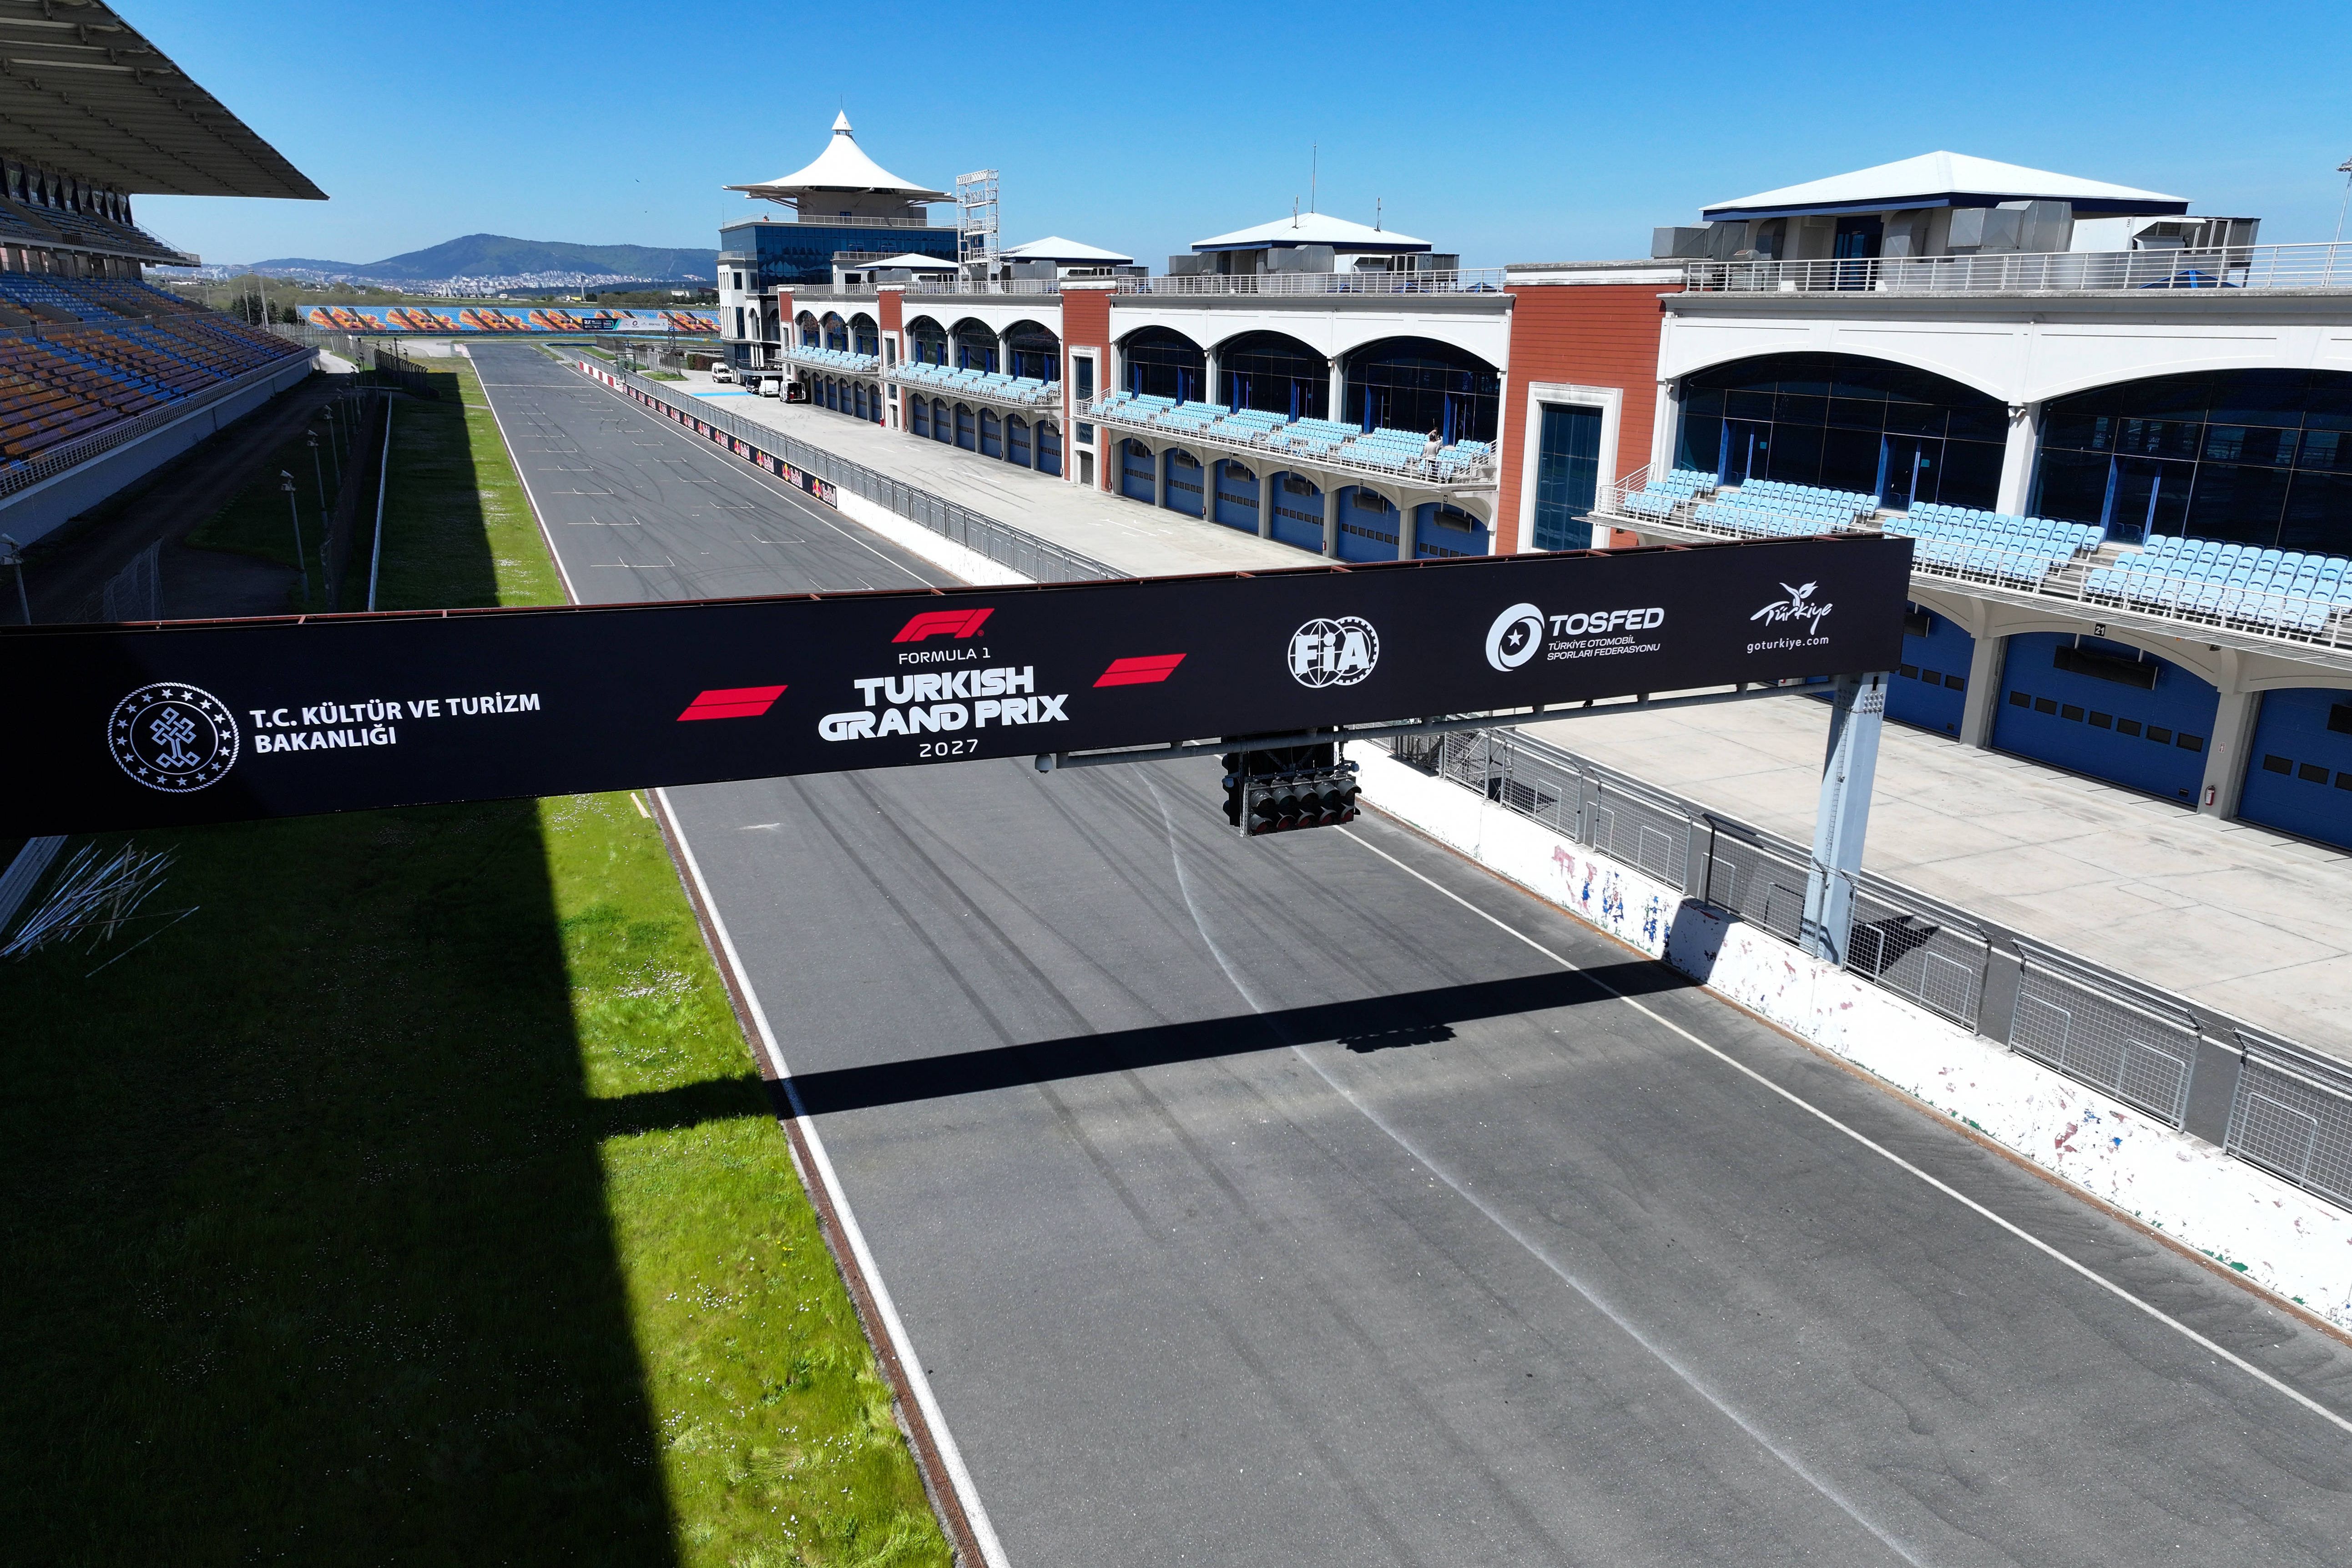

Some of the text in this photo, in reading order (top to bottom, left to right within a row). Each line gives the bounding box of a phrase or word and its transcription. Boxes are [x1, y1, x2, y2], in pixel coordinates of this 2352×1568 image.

[1549, 607, 1665, 636] TOSFED
[1750, 600, 1833, 635] Türkiye
[2095, 626, 2105, 635] 21
[1547, 643, 1661, 660] SPORLARI FEDERASYONU
[1549, 635, 1635, 650] TÜRKİYE OTOMOBİL
[1747, 637, 1829, 654] goturkiye.com
[898, 647, 991, 665] FORMULA 1
[854, 666, 1034, 706] TURKISH
[249, 691, 540, 728] T.C. KÜLTÜR VE TURİZM
[818, 694, 1070, 741] GRAND PRIX
[254, 723, 396, 753] BAKANLIĞI
[919, 739, 978, 757] 2027
